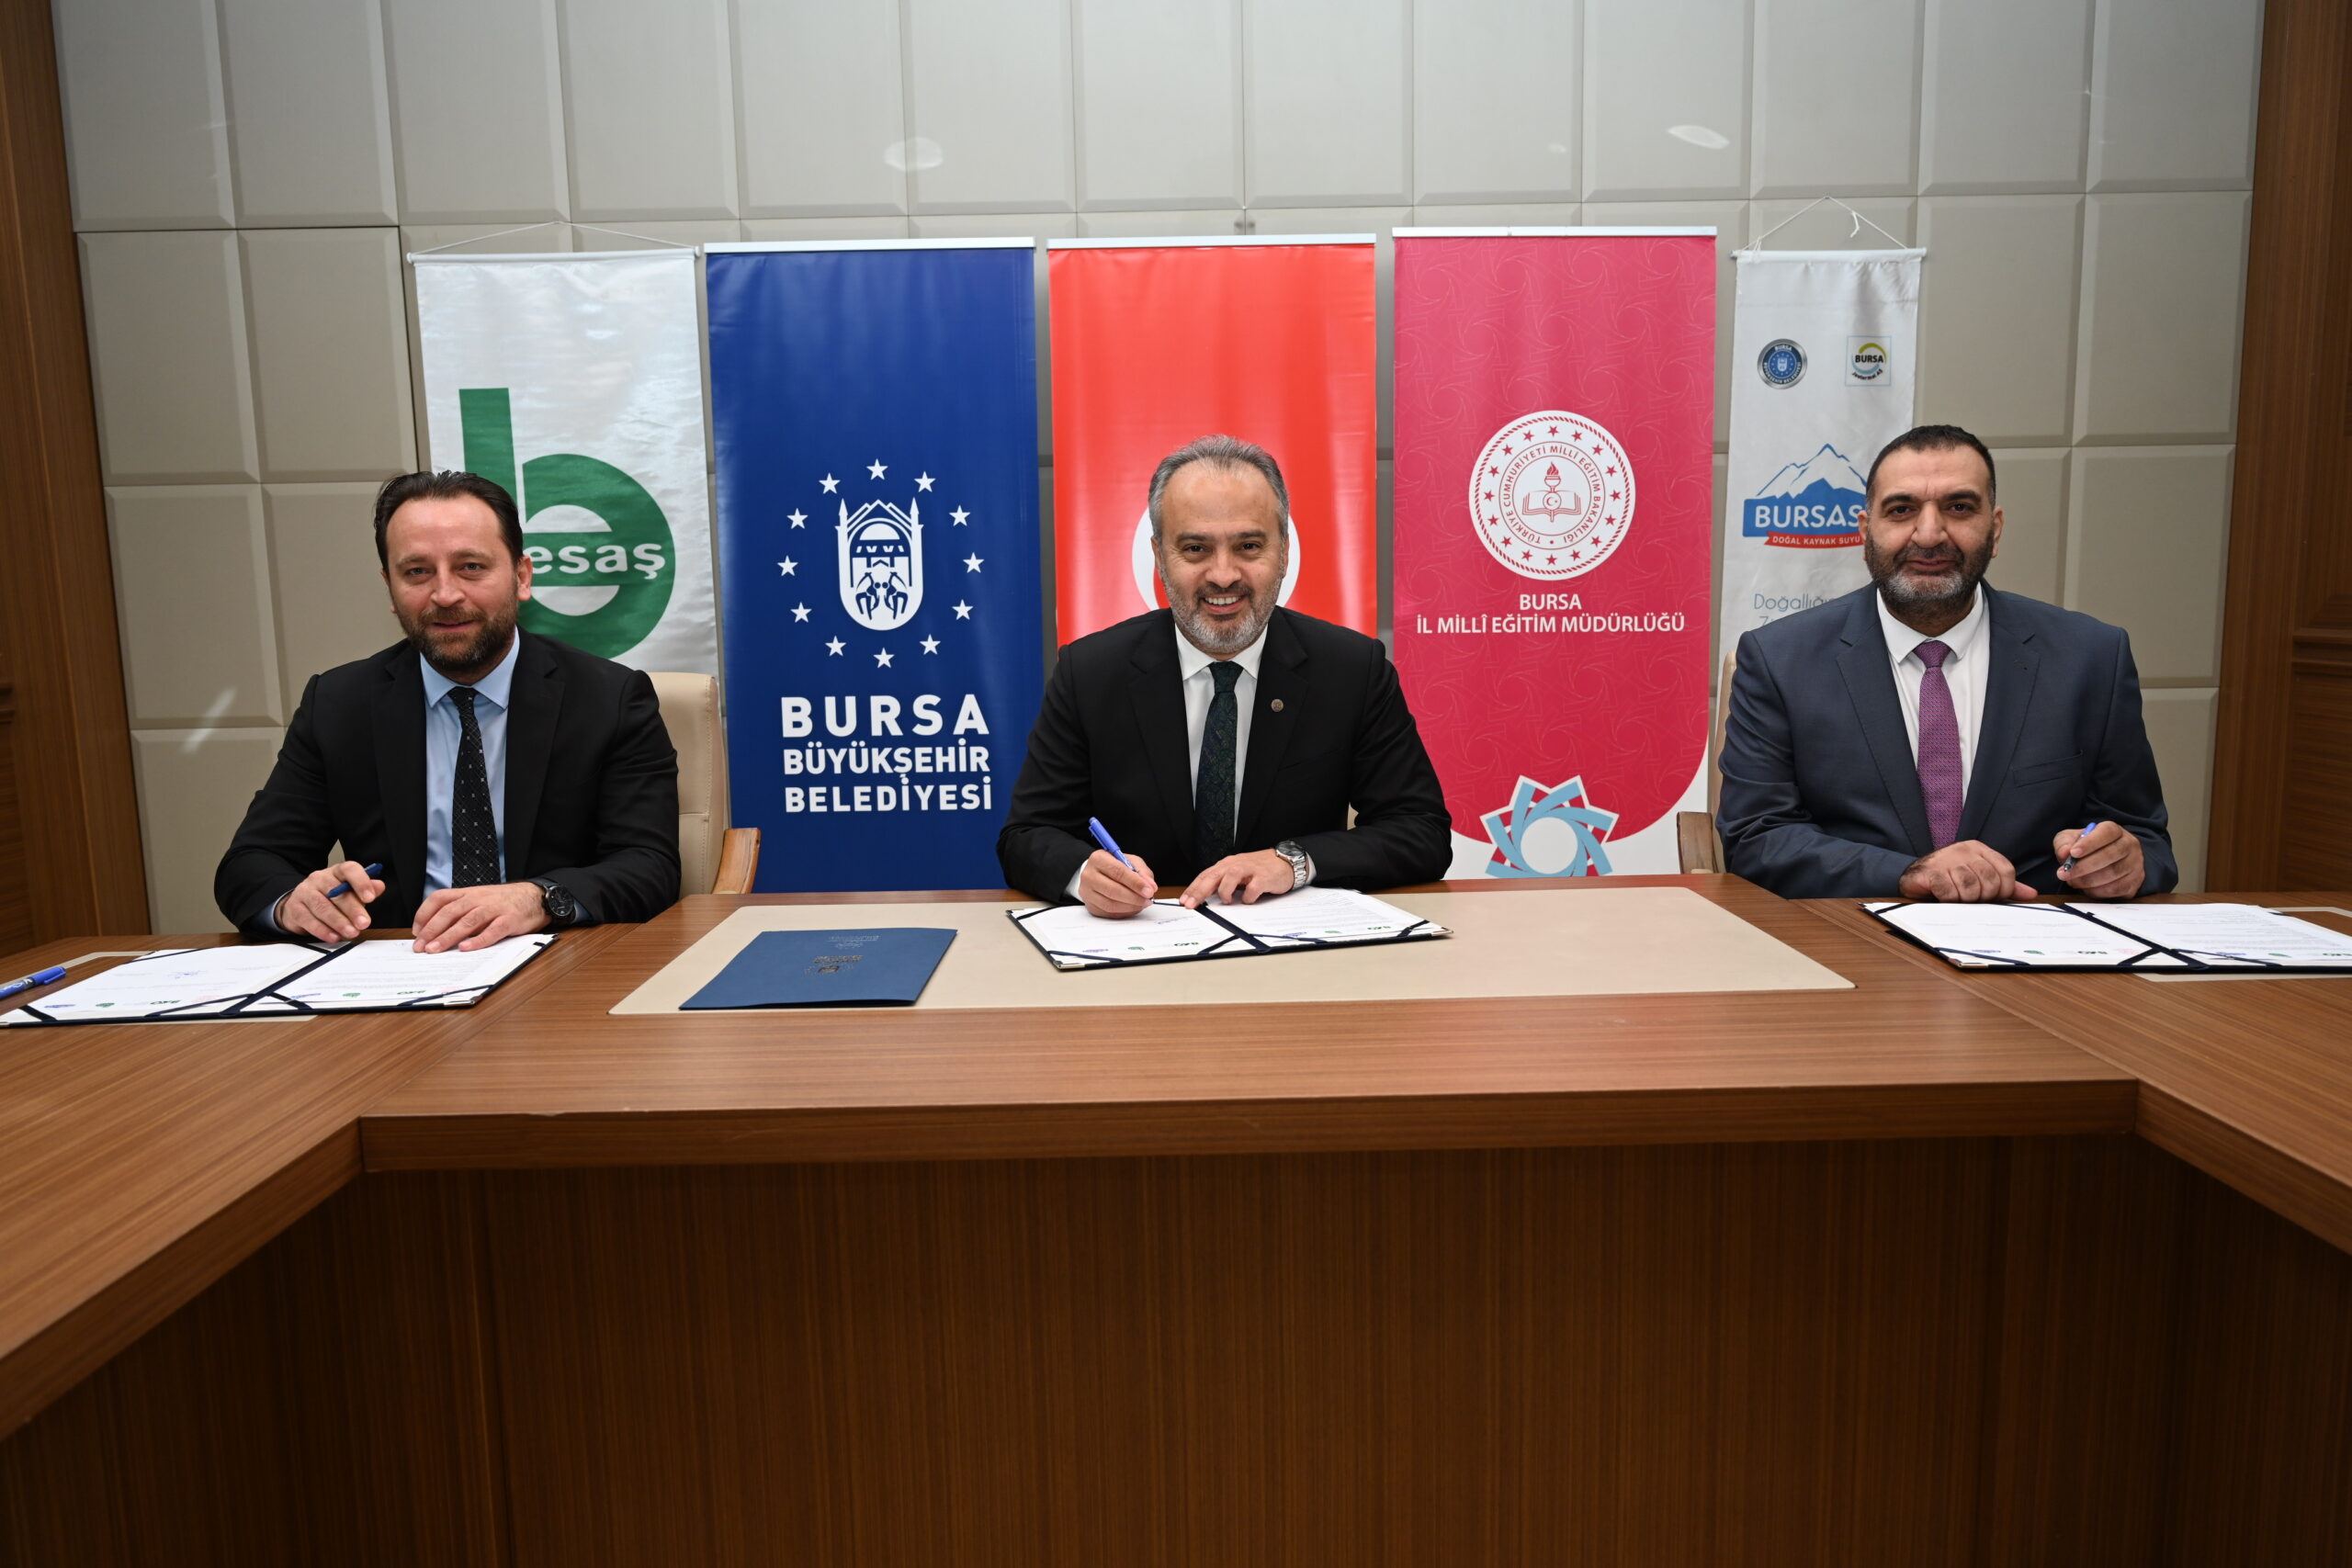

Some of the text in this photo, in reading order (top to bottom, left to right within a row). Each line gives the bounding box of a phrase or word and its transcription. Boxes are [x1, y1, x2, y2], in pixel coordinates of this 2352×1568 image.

[1855, 355, 1883, 363] BURSA
[1503, 445, 1546, 507] CUMHURİYETİ
[1578, 457, 1601, 492] EĞİTİM
[1563, 496, 1601, 544] BAKANLIĞI
[1755, 504, 1863, 528] BURSAS
[1772, 536, 1801, 545] DOĞAL
[1838, 536, 1860, 544] SUYU
[522, 543, 665, 580] esaş
[1519, 593, 1582, 611] BURSA
[1754, 593, 1835, 613] Doğallığ
[1417, 612, 1685, 634] İL MİLLÎ EĞİTİM MÜDÜRLÜĞÜ
[781, 694, 990, 739] BURSA
[783, 738, 991, 778] BÜYÜKŞEHİR
[785, 775, 992, 813] BELEDİYESİ
